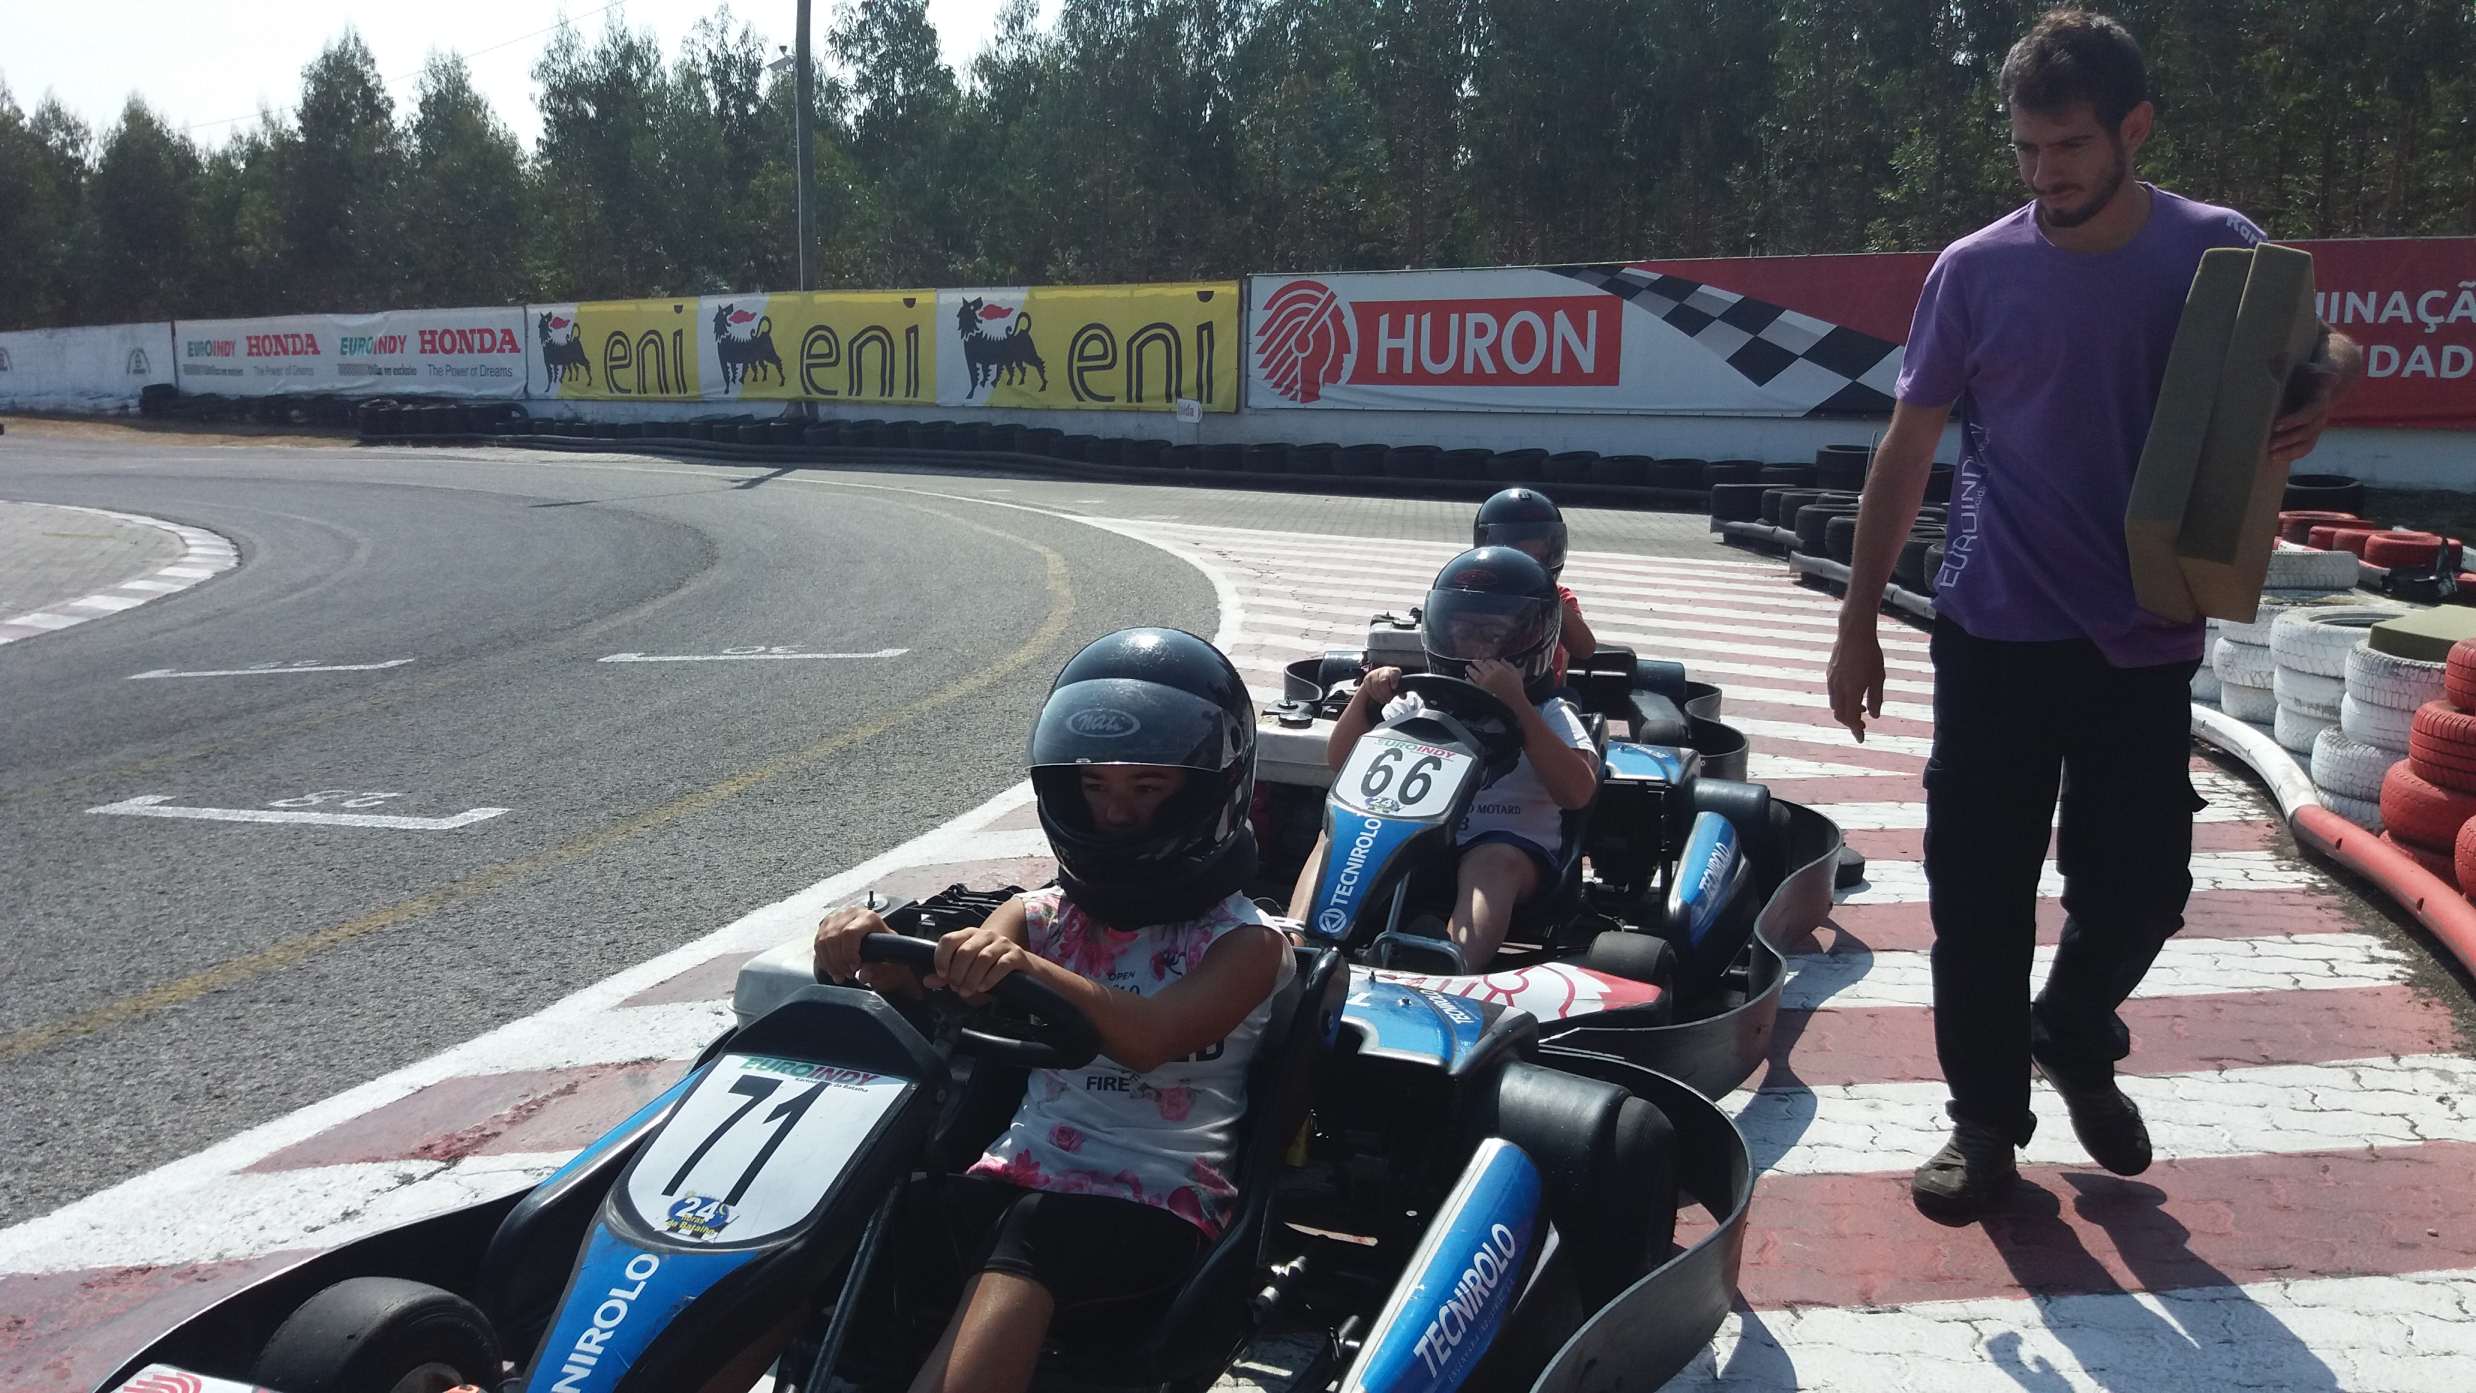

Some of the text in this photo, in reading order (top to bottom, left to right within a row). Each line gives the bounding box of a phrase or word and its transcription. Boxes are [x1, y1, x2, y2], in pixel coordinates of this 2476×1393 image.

[246, 333, 321, 357] HONDA
[340, 335, 408, 355] EUROINDY
[418, 328, 521, 355] HONDA
[604, 305, 688, 394] eni
[801, 298, 919, 398] eni
[1067, 291, 1214, 404] eni
[1377, 309, 1597, 376] HURON
[428, 364, 444, 377] The
[1360, 747, 1442, 805] 66
[1330, 818, 1382, 906] TECNIROLO
[1108, 971, 1135, 981] OPEN
[740, 1056, 881, 1086] EUROINDY
[1086, 1076, 1130, 1092] FIRE
[661, 1074, 831, 1207] 71
[675, 1196, 721, 1222] 24
[1413, 1223, 1516, 1379] TECNIROLO
